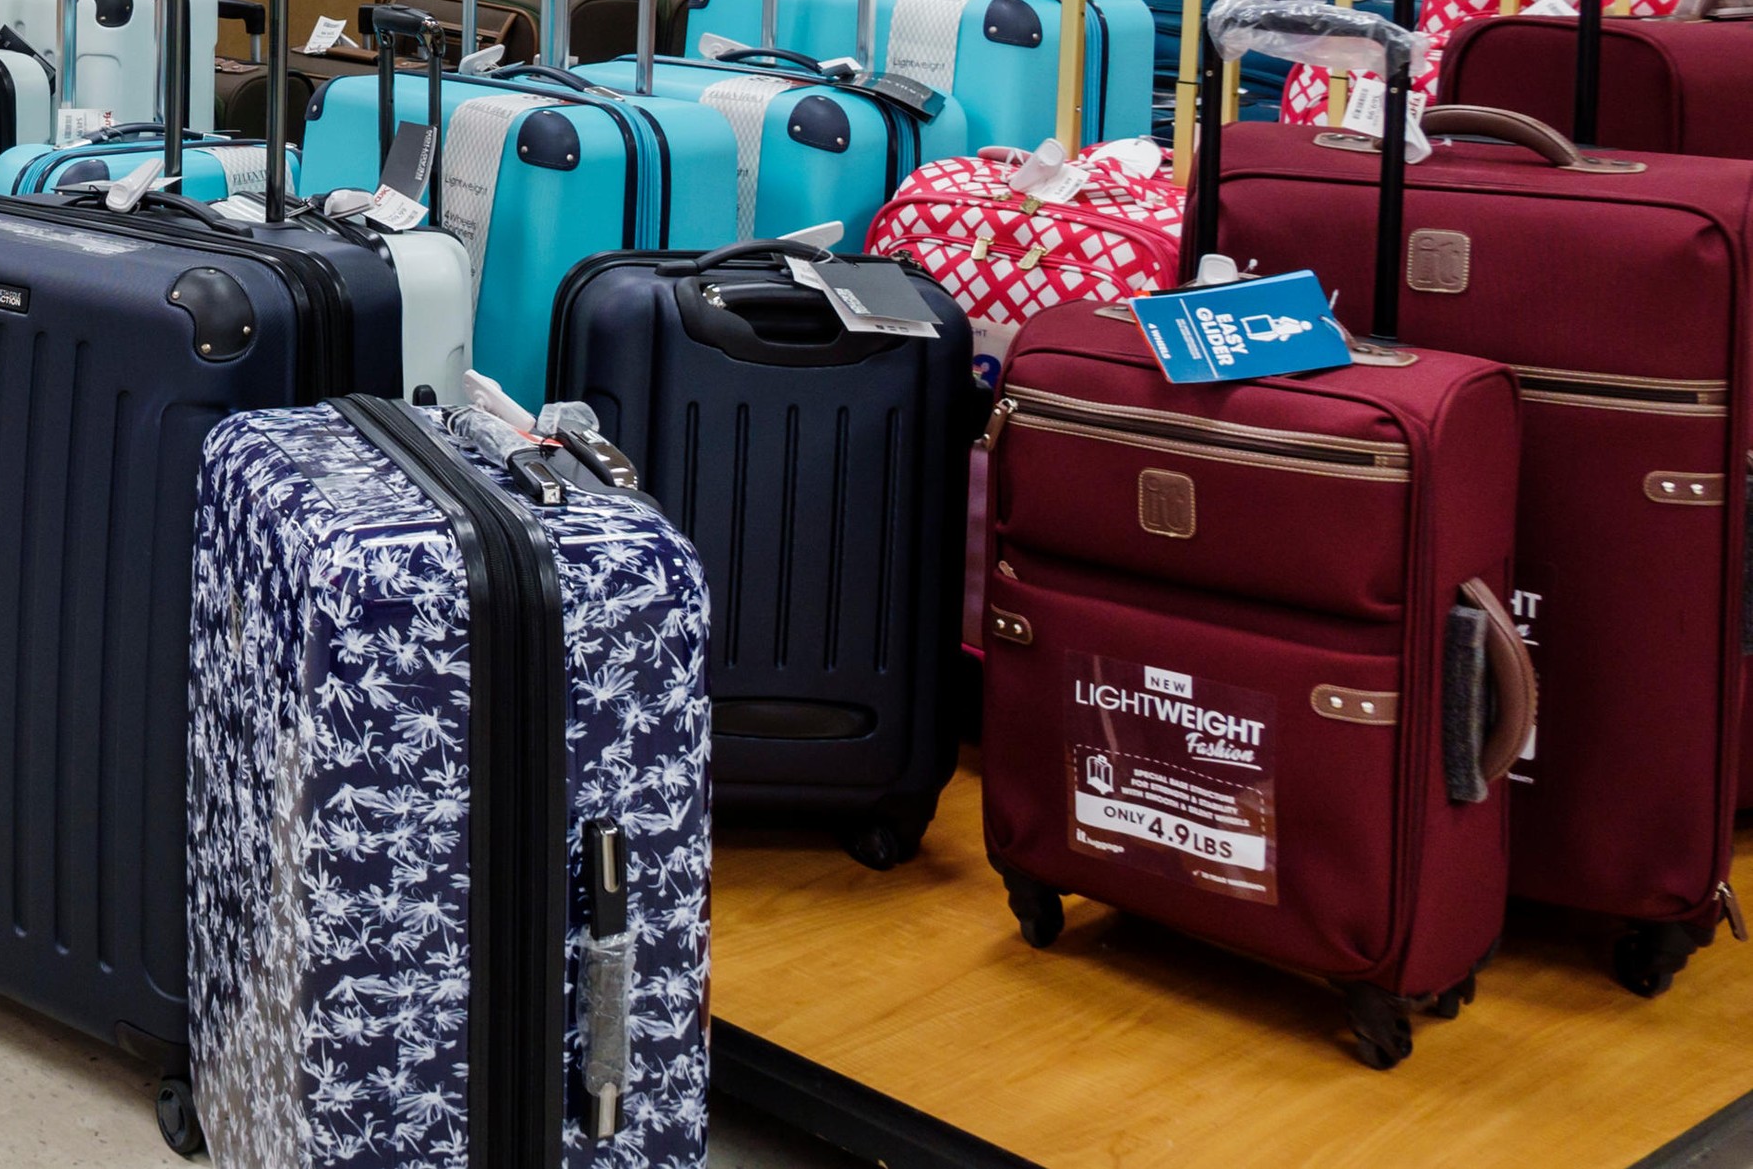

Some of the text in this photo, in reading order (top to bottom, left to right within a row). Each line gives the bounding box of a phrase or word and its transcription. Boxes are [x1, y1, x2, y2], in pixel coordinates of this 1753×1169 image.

[893, 57, 945, 73] Lightweight
[444, 173, 488, 196] Lightweight
[1151, 329, 1172, 359] WHEELS
[1195, 307, 1235, 366] GLIDER
[1215, 313, 1249, 355] EASY
[1150, 675, 1186, 693] NEW
[1075, 680, 1265, 746] LIGHTWEIGHT
[1185, 732, 1255, 763] Fashion
[1104, 805, 1233, 858] ONLY 4.9 LBS
